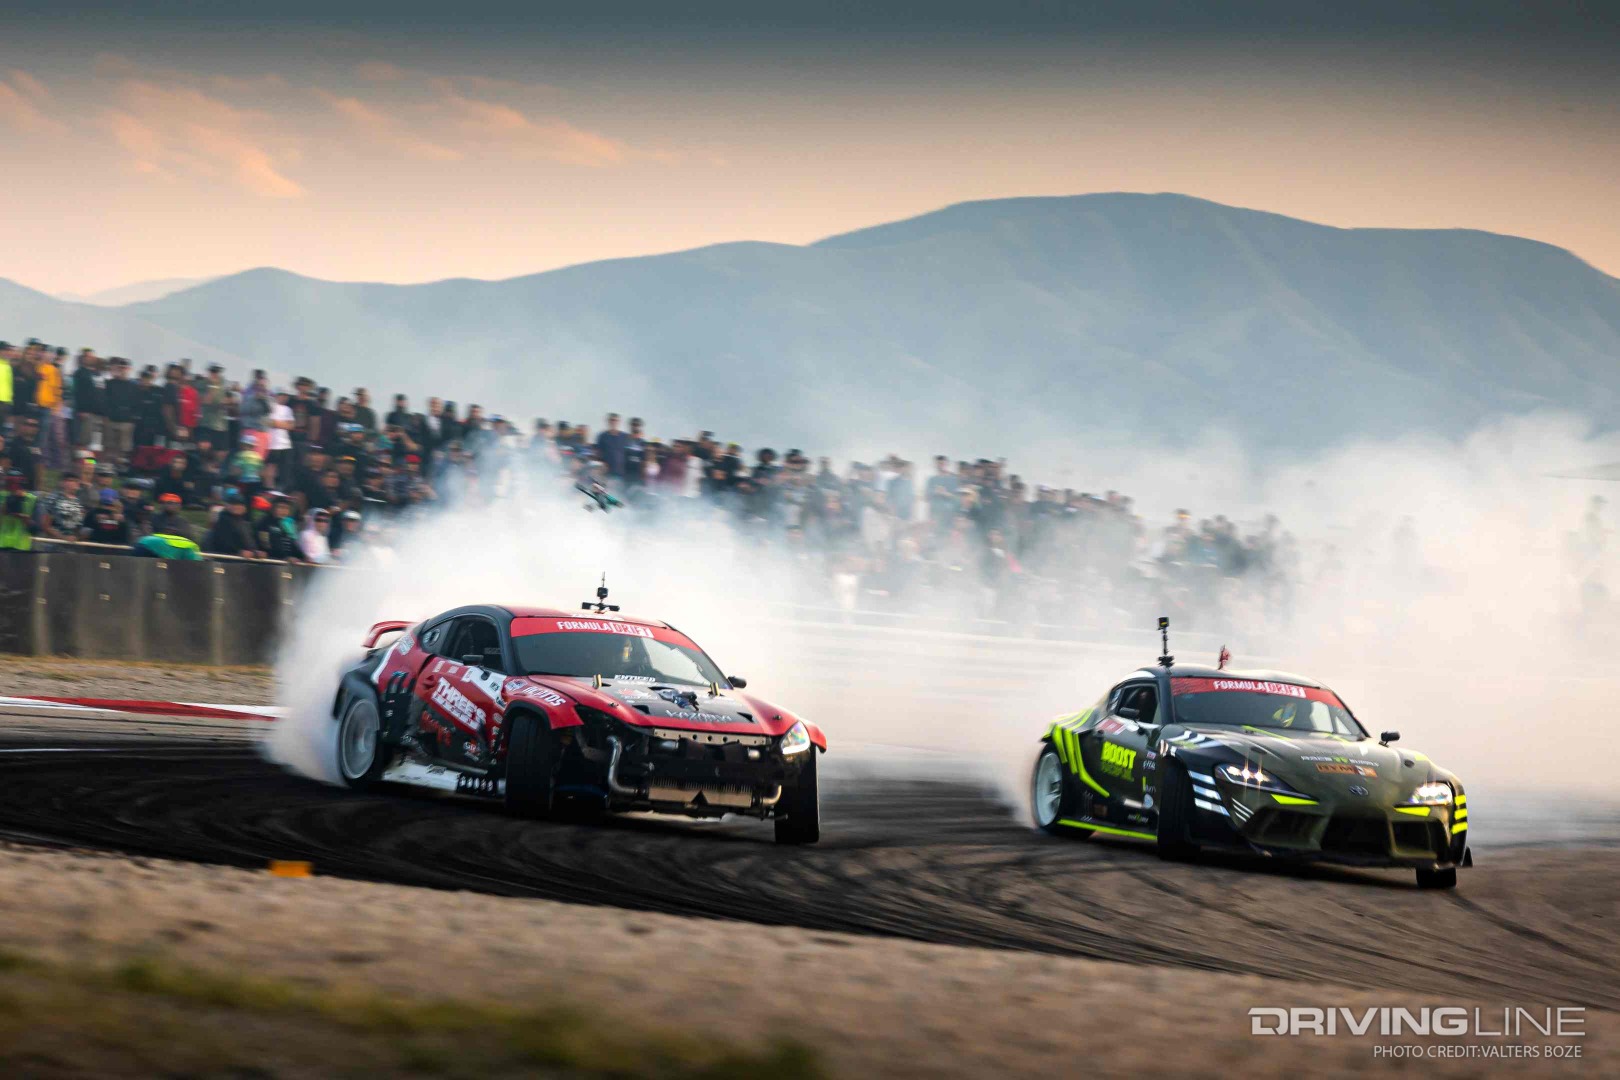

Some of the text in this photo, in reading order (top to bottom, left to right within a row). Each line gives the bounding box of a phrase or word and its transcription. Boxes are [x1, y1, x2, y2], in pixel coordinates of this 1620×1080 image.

[556, 620, 655, 638] FORMULA DRIFT
[1213, 680, 1265, 691] FORMULA
[1101, 741, 1137, 769] BOOST
